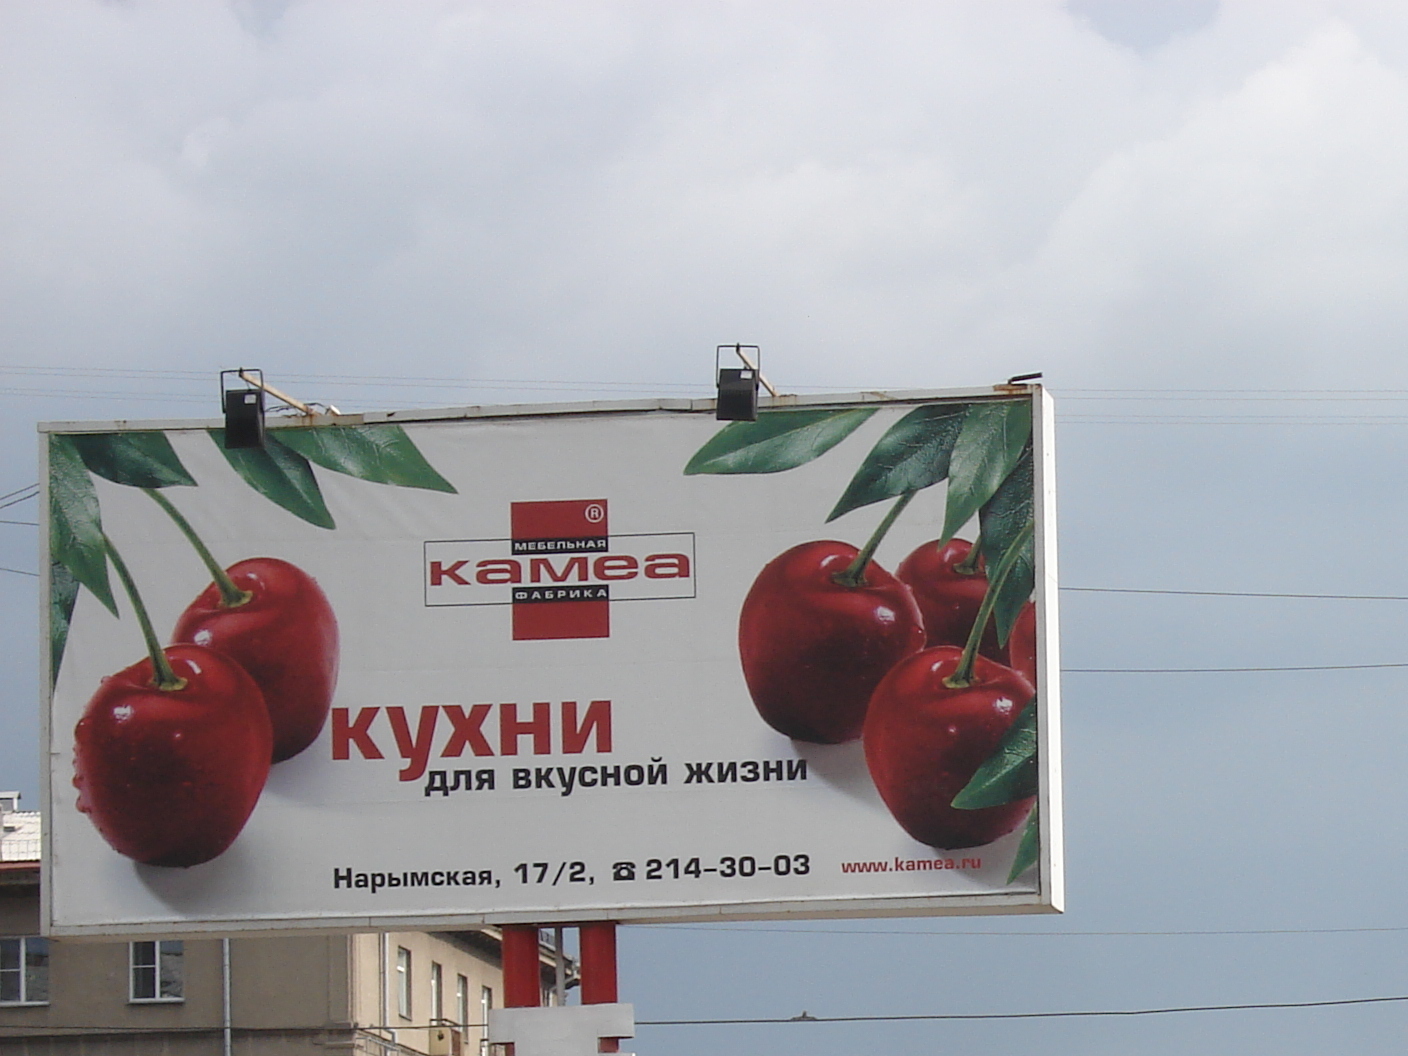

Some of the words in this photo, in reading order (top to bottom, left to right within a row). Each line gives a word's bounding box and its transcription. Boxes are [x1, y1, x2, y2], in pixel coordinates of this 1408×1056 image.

[513, 538, 607, 552] МЕБЕЛЬНАЯ
[514, 587, 608, 601] ФАБРИКА
[424, 768, 496, 797] для
[512, 757, 669, 797] вкусной
[684, 758, 808, 784] жизни
[333, 866, 502, 891] Нарымская,
[513, 861, 597, 887] 17/2,
[645, 853, 811, 880] 214-30-03
[841, 856, 982, 874] www.kamea.ru
